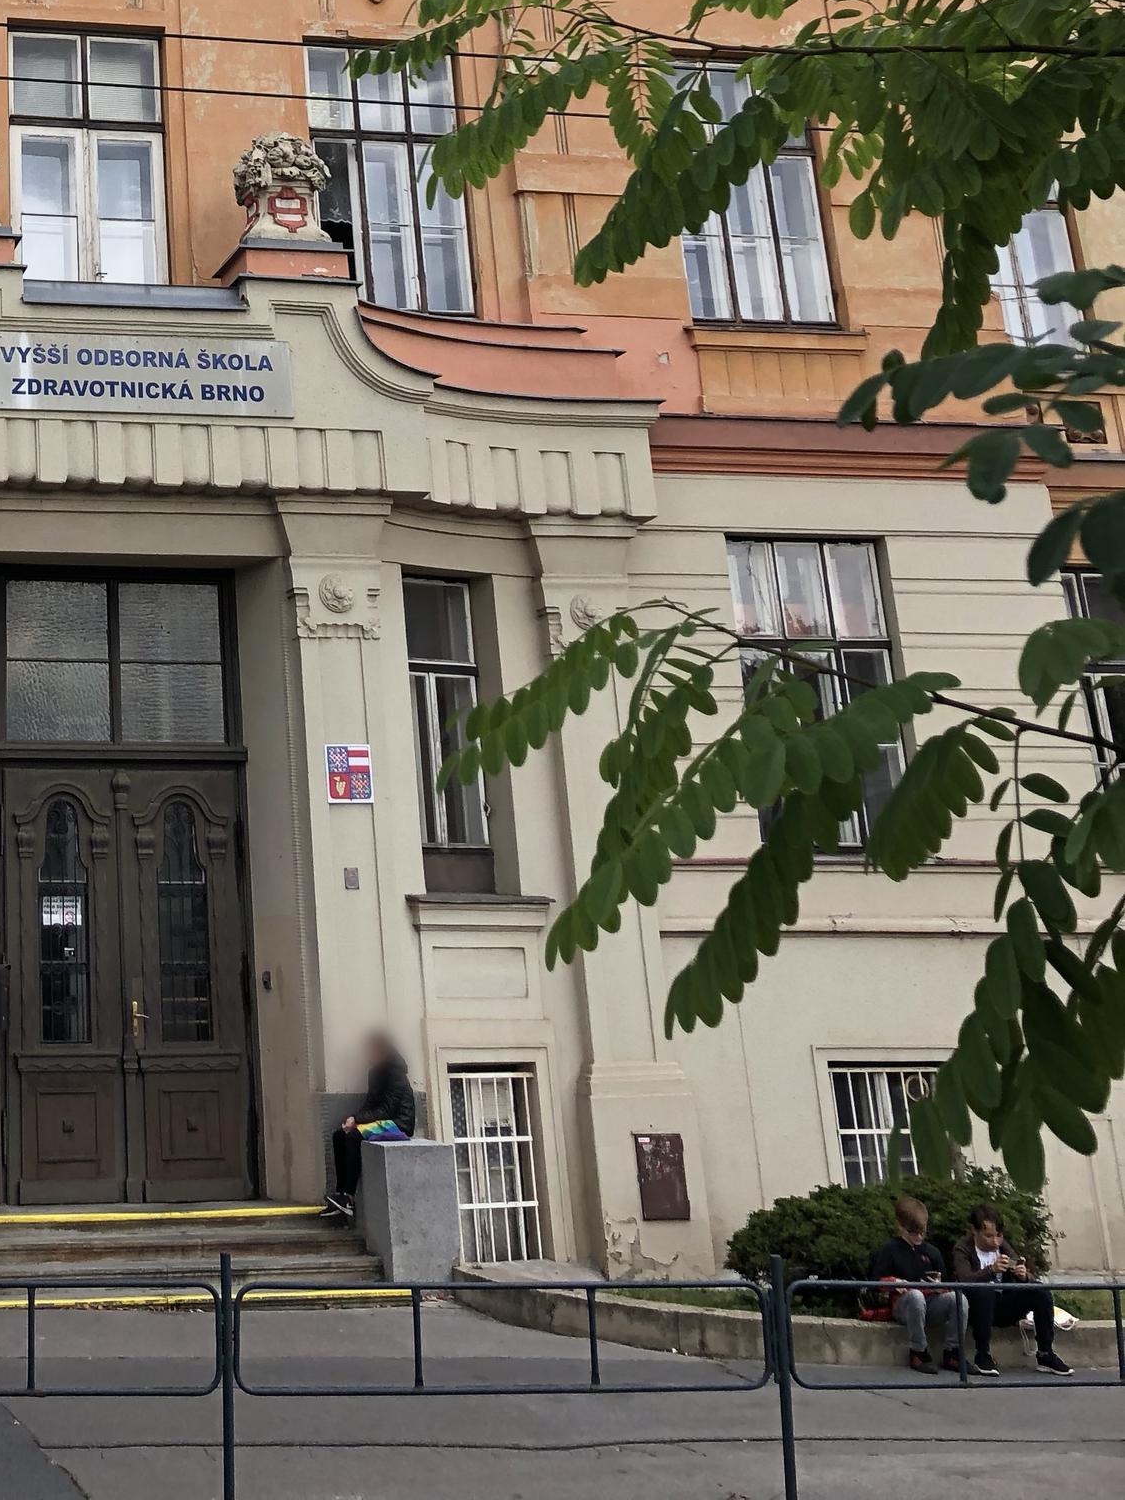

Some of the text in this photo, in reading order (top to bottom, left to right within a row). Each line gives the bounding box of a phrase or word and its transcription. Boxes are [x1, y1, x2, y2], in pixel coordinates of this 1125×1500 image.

[0, 343, 273, 371] VYŠŠÍ ODBORNÁ ŠKOLA
[11, 378, 264, 402] ZDRAVOTNICKÁ BRNO
